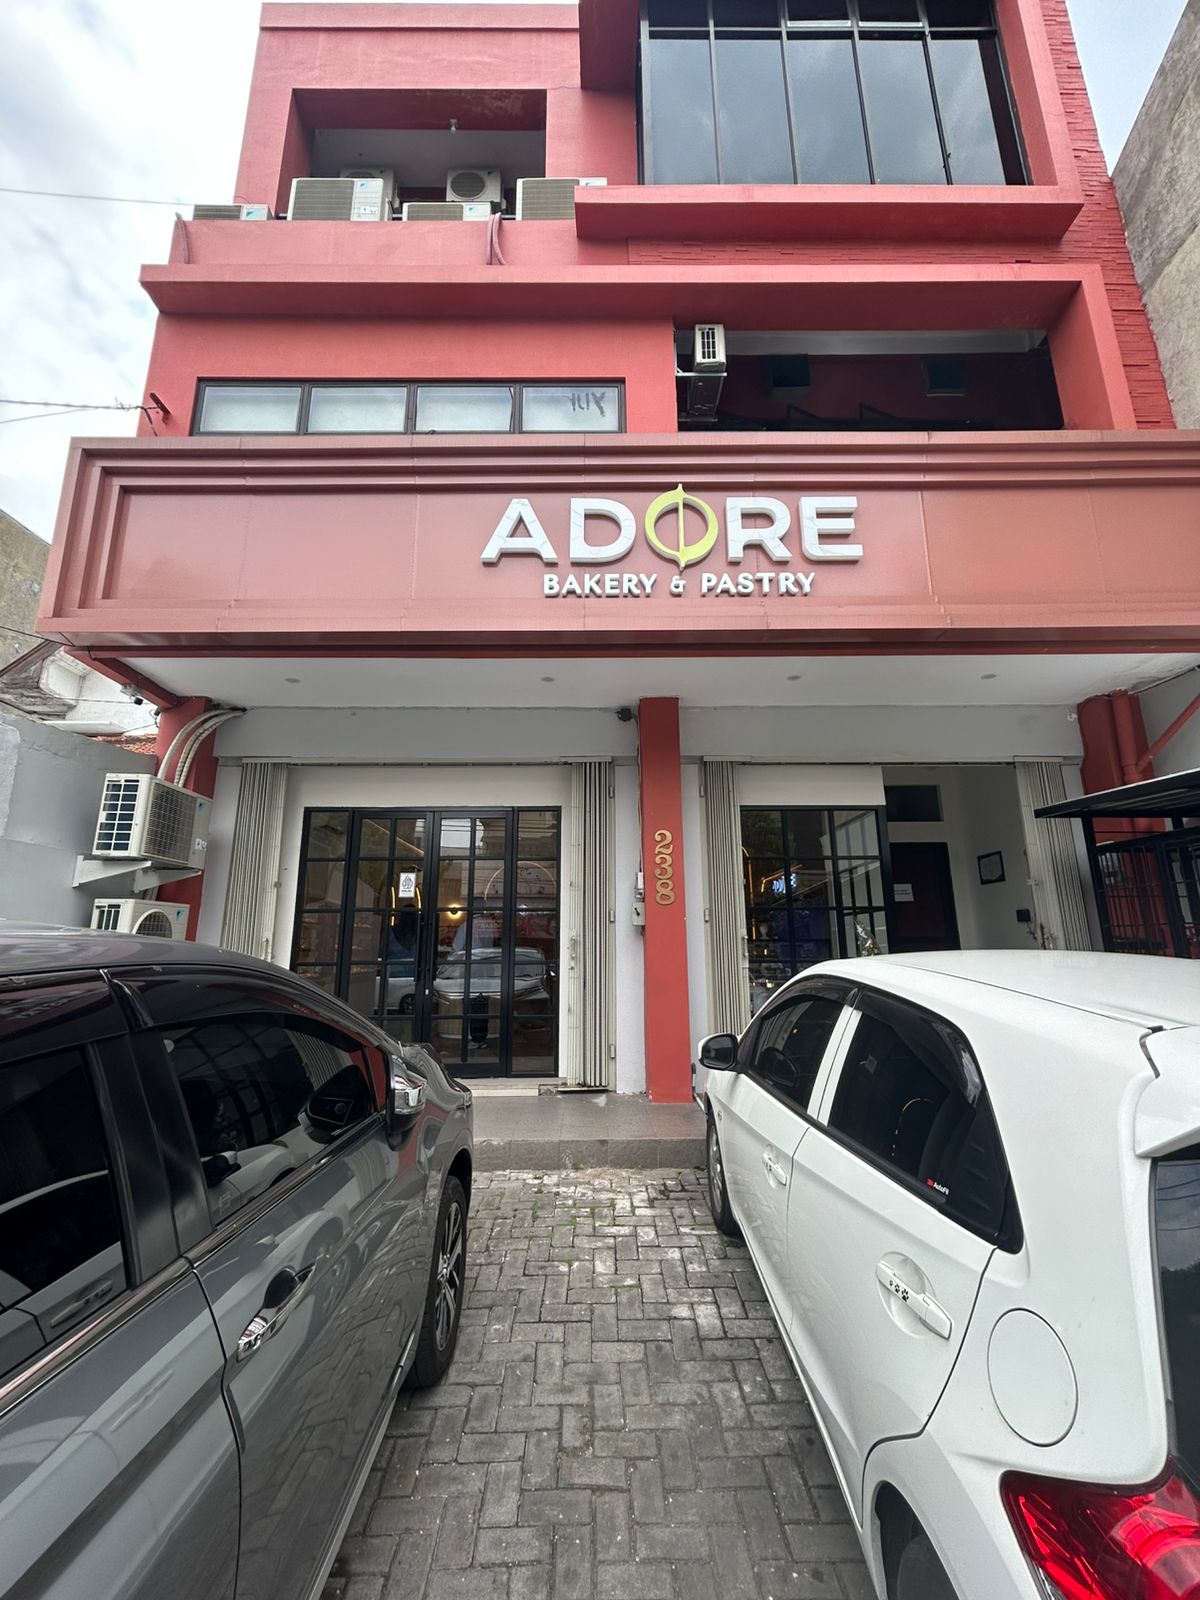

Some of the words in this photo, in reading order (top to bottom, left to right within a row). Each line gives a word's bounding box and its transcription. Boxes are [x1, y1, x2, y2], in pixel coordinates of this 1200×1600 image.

[480, 484, 864, 570] ADORE
[543, 573, 658, 597] BAKERY
[670, 575, 686, 596] &
[701, 572, 816, 597] PASTRY
[654, 829, 675, 906] 238
